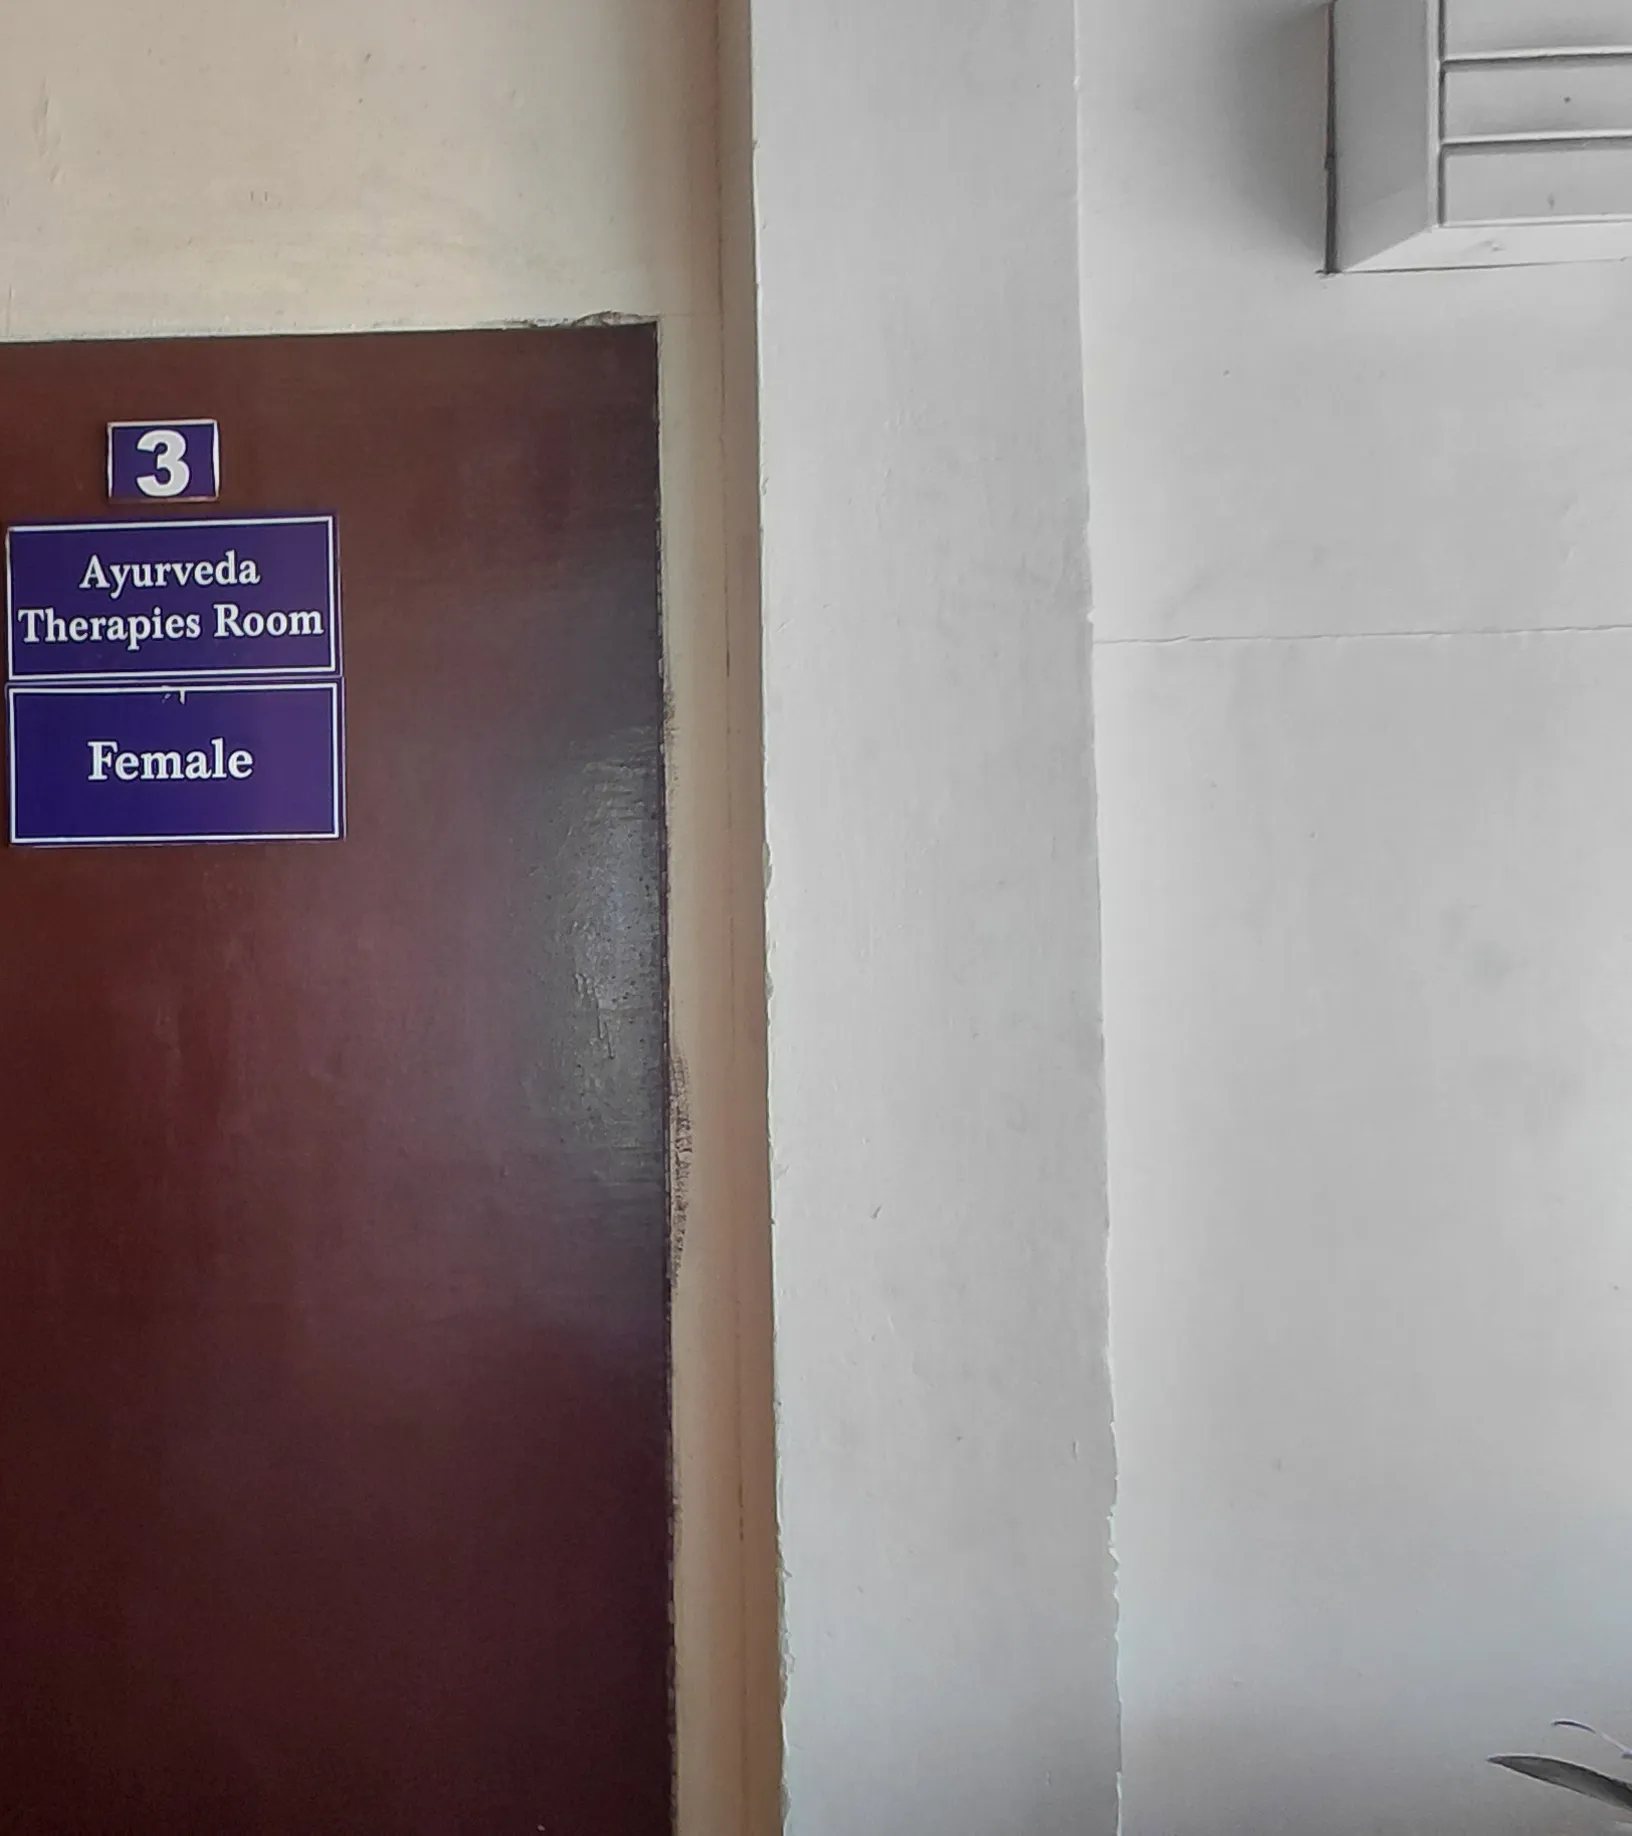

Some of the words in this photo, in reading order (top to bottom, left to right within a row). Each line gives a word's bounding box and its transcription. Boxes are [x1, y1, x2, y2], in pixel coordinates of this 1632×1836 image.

[136, 429, 191, 497] 3
[79, 550, 260, 598] Ayurveda
[17, 607, 201, 650] Therapies
[213, 603, 324, 638] Room
[87, 737, 253, 781] Female
